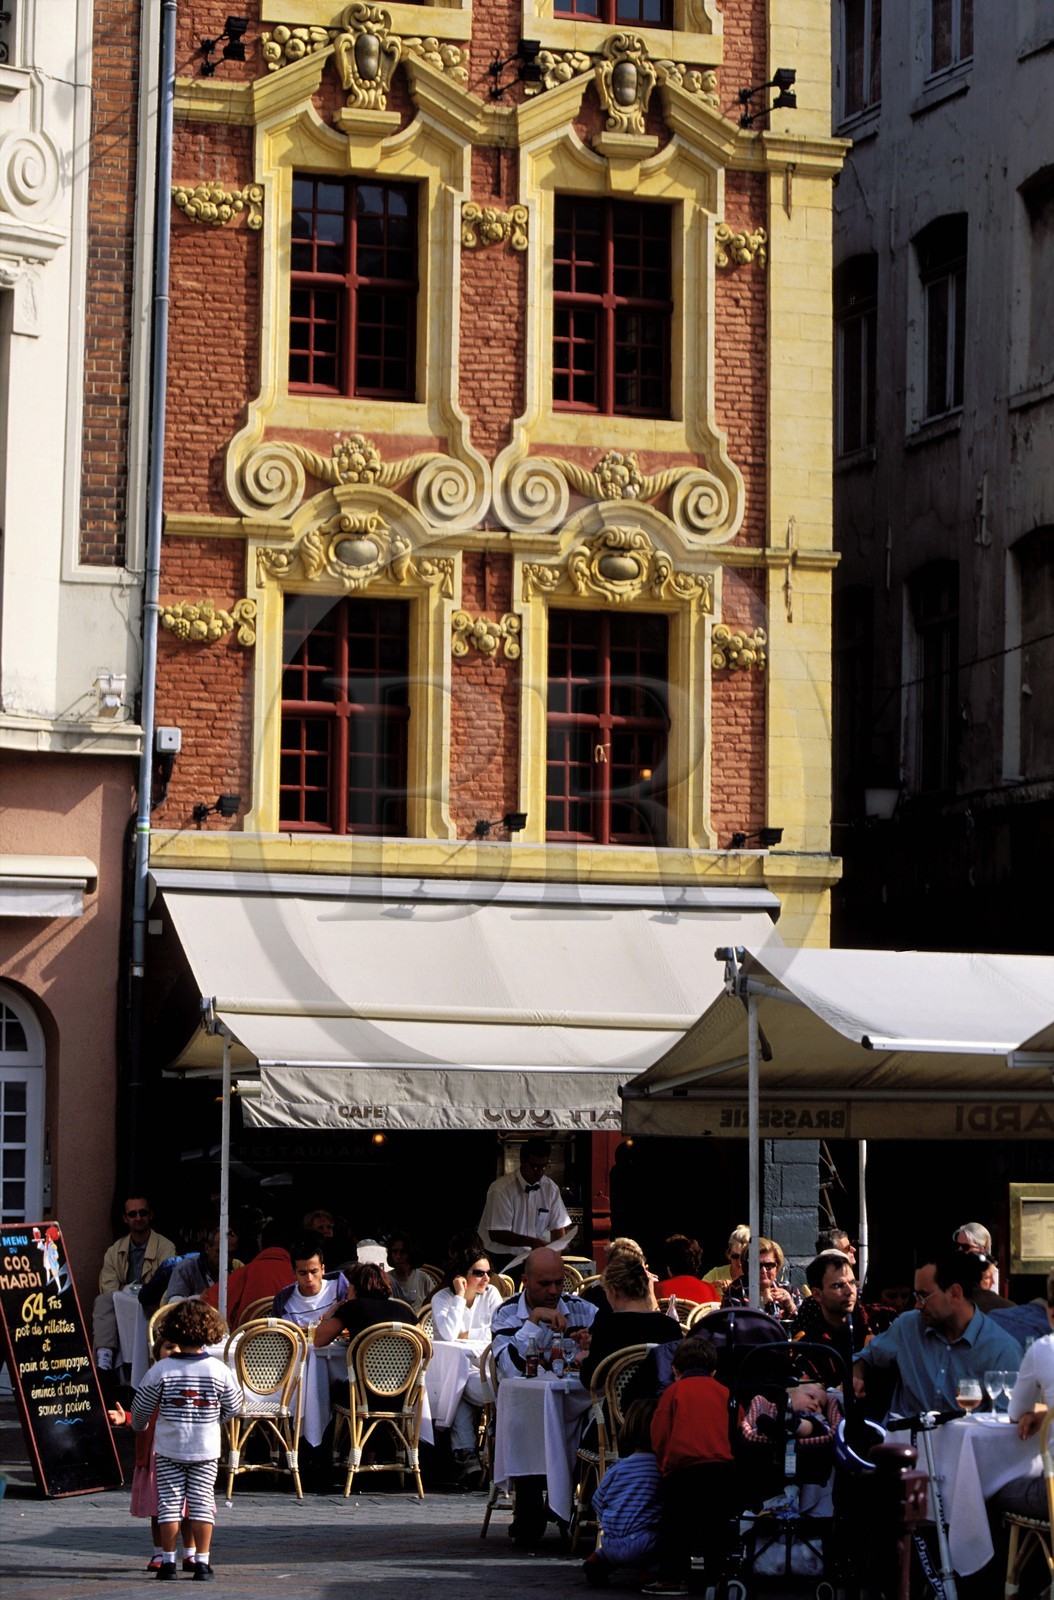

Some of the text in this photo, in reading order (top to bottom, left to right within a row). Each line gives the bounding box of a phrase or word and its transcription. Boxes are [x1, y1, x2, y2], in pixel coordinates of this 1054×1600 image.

[2, 1235, 29, 1247] MENU
[4, 1255, 31, 1272] COQ
[0, 1272, 42, 1290] HARDI
[21, 1292, 47, 1323] 64
[15, 1318, 75, 1342] pot de rillettes
[42, 1337, 51, 1352] et
[19, 1355, 90, 1379] pain de campagne
[38, 1398, 91, 1417] sauce poivre
